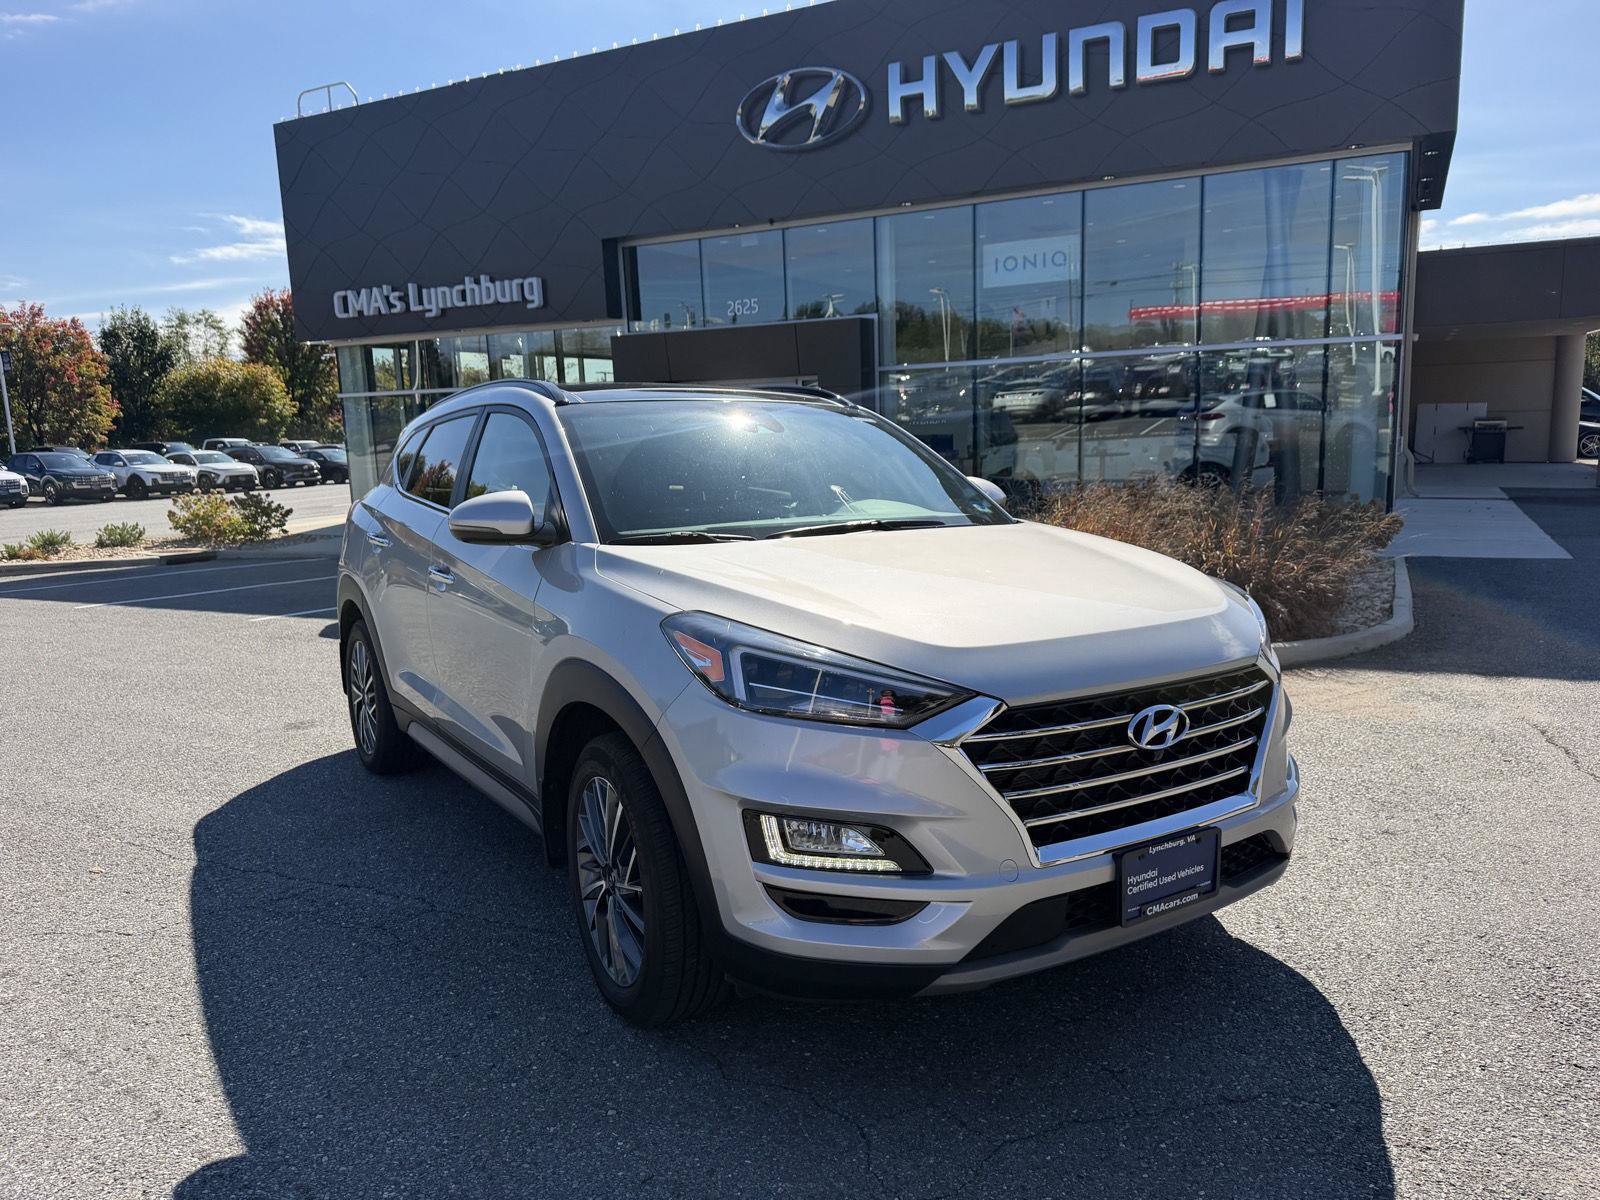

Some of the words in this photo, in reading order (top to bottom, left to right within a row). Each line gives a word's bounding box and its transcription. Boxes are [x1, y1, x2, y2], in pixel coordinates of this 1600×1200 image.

[887, 0, 1304, 124] HYUNDAI
[994, 250, 1067, 274] IONIQ
[333, 284, 406, 319] CMA's
[408, 274, 544, 318] Lynchburg
[727, 298, 759, 316] 2625
[1187, 834, 1196, 843] VA
[1127, 868, 1158, 885] Hyundai
[1127, 878, 1158, 895] Certified
[1159, 872, 1177, 885] Used
[1176, 864, 1204, 879] Vehicles
[1146, 892, 1199, 916] CMAcars.com
